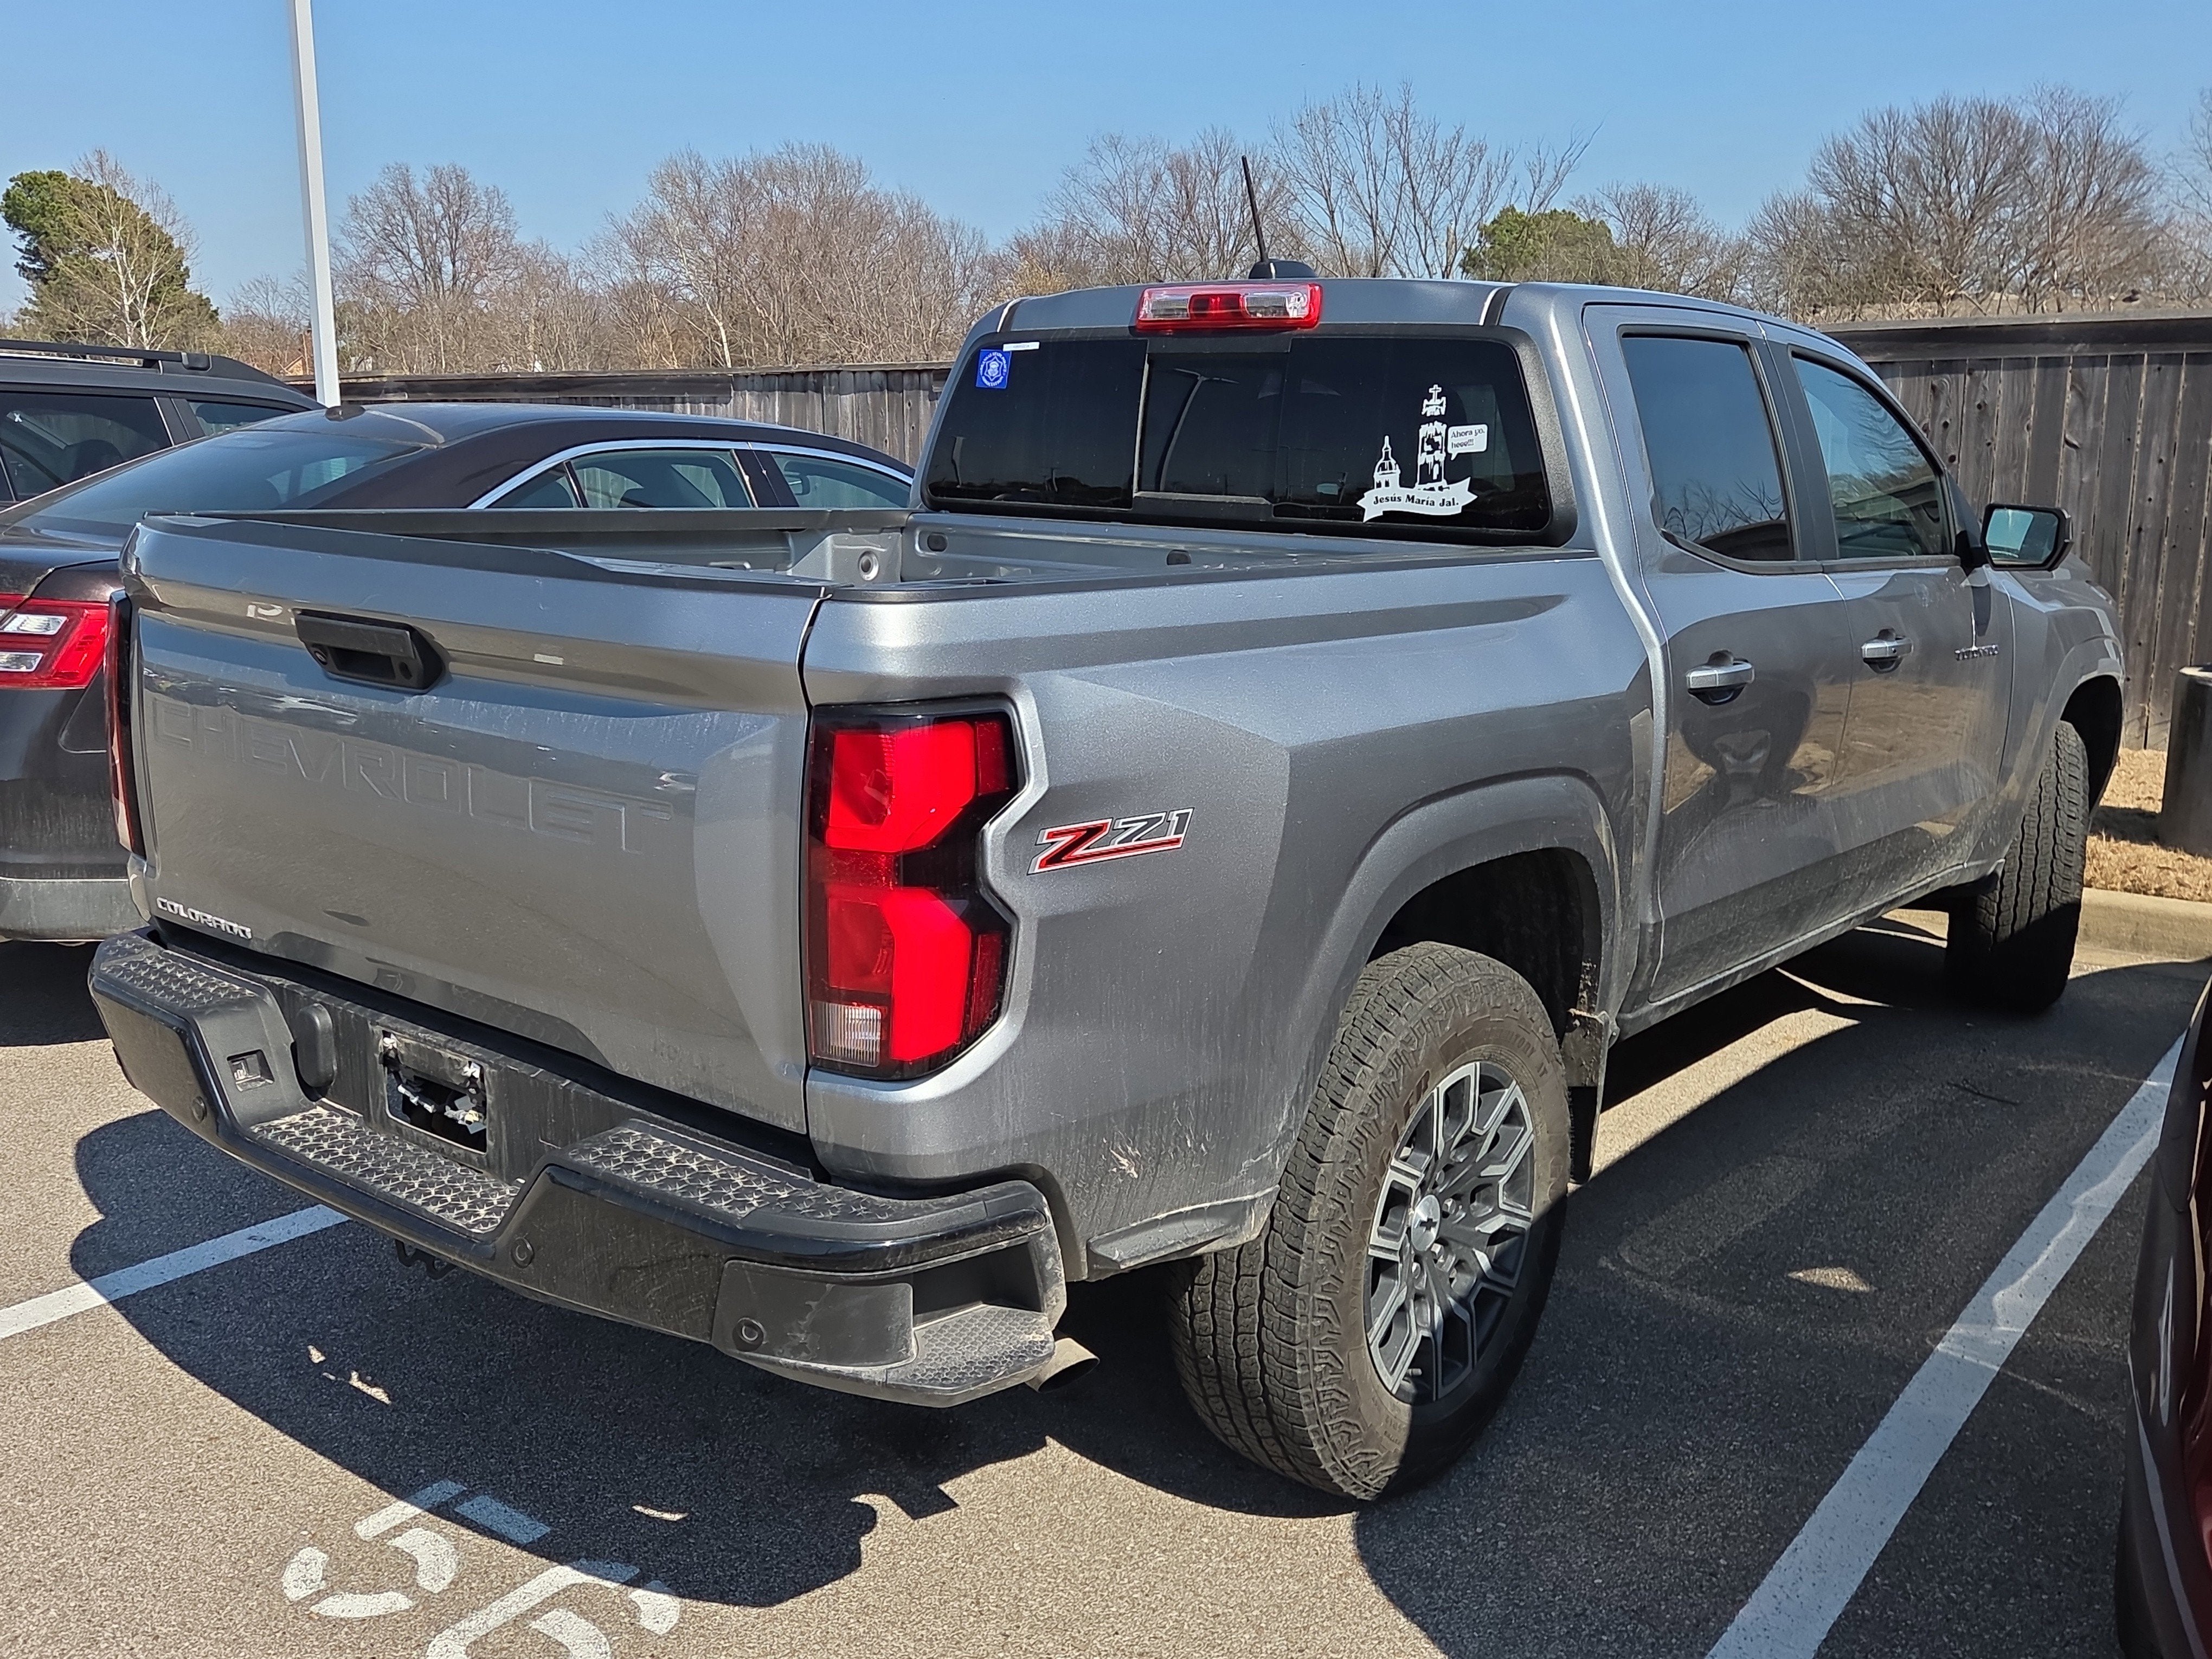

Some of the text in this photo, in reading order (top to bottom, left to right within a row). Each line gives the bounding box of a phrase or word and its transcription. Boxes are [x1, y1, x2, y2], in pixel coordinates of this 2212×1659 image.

[1451, 430, 1473, 439] Ahora
[1373, 493, 1459, 507] Jesús María Jal.
[151, 695, 673, 854] CHEVROLET
[1026, 807, 1195, 876] Z71
[156, 897, 253, 940] COLORADO
